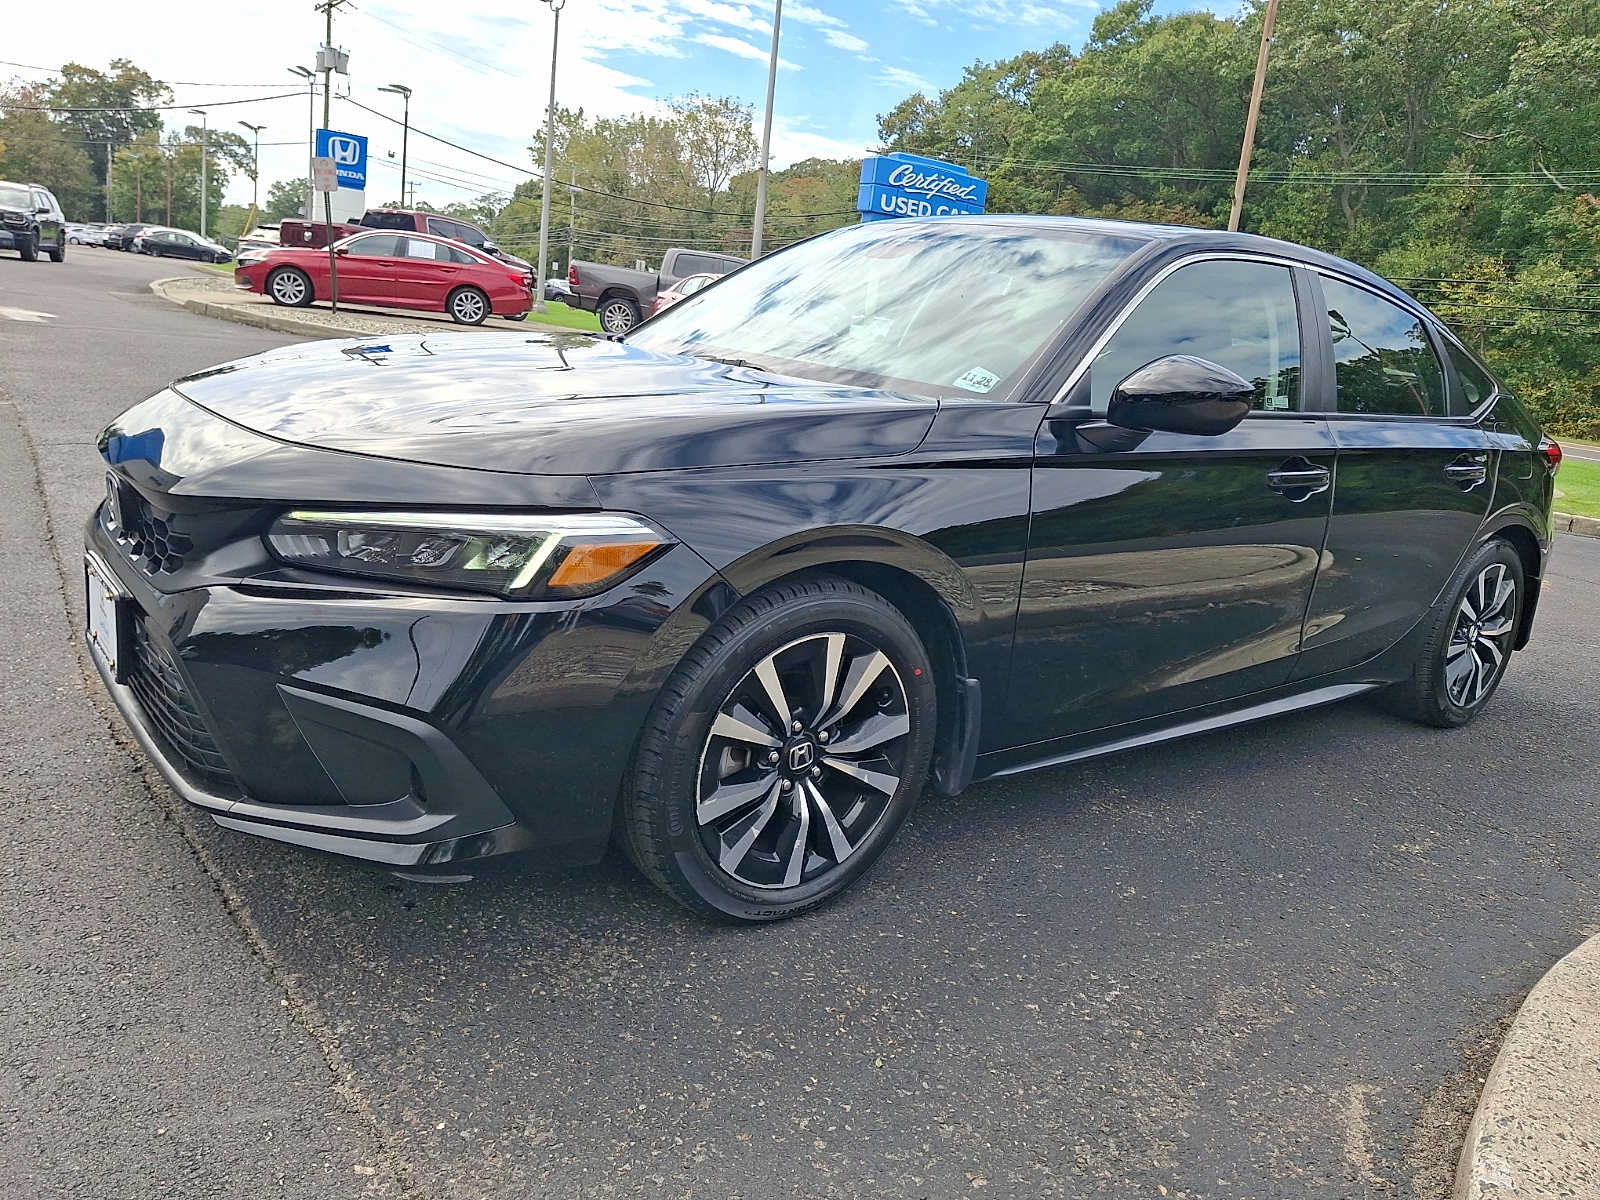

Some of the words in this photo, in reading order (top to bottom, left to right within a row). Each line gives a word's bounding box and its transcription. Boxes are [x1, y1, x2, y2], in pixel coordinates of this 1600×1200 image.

[336, 169, 365, 180] NDA
[888, 164, 978, 200] Certified
[880, 193, 932, 217] USED
